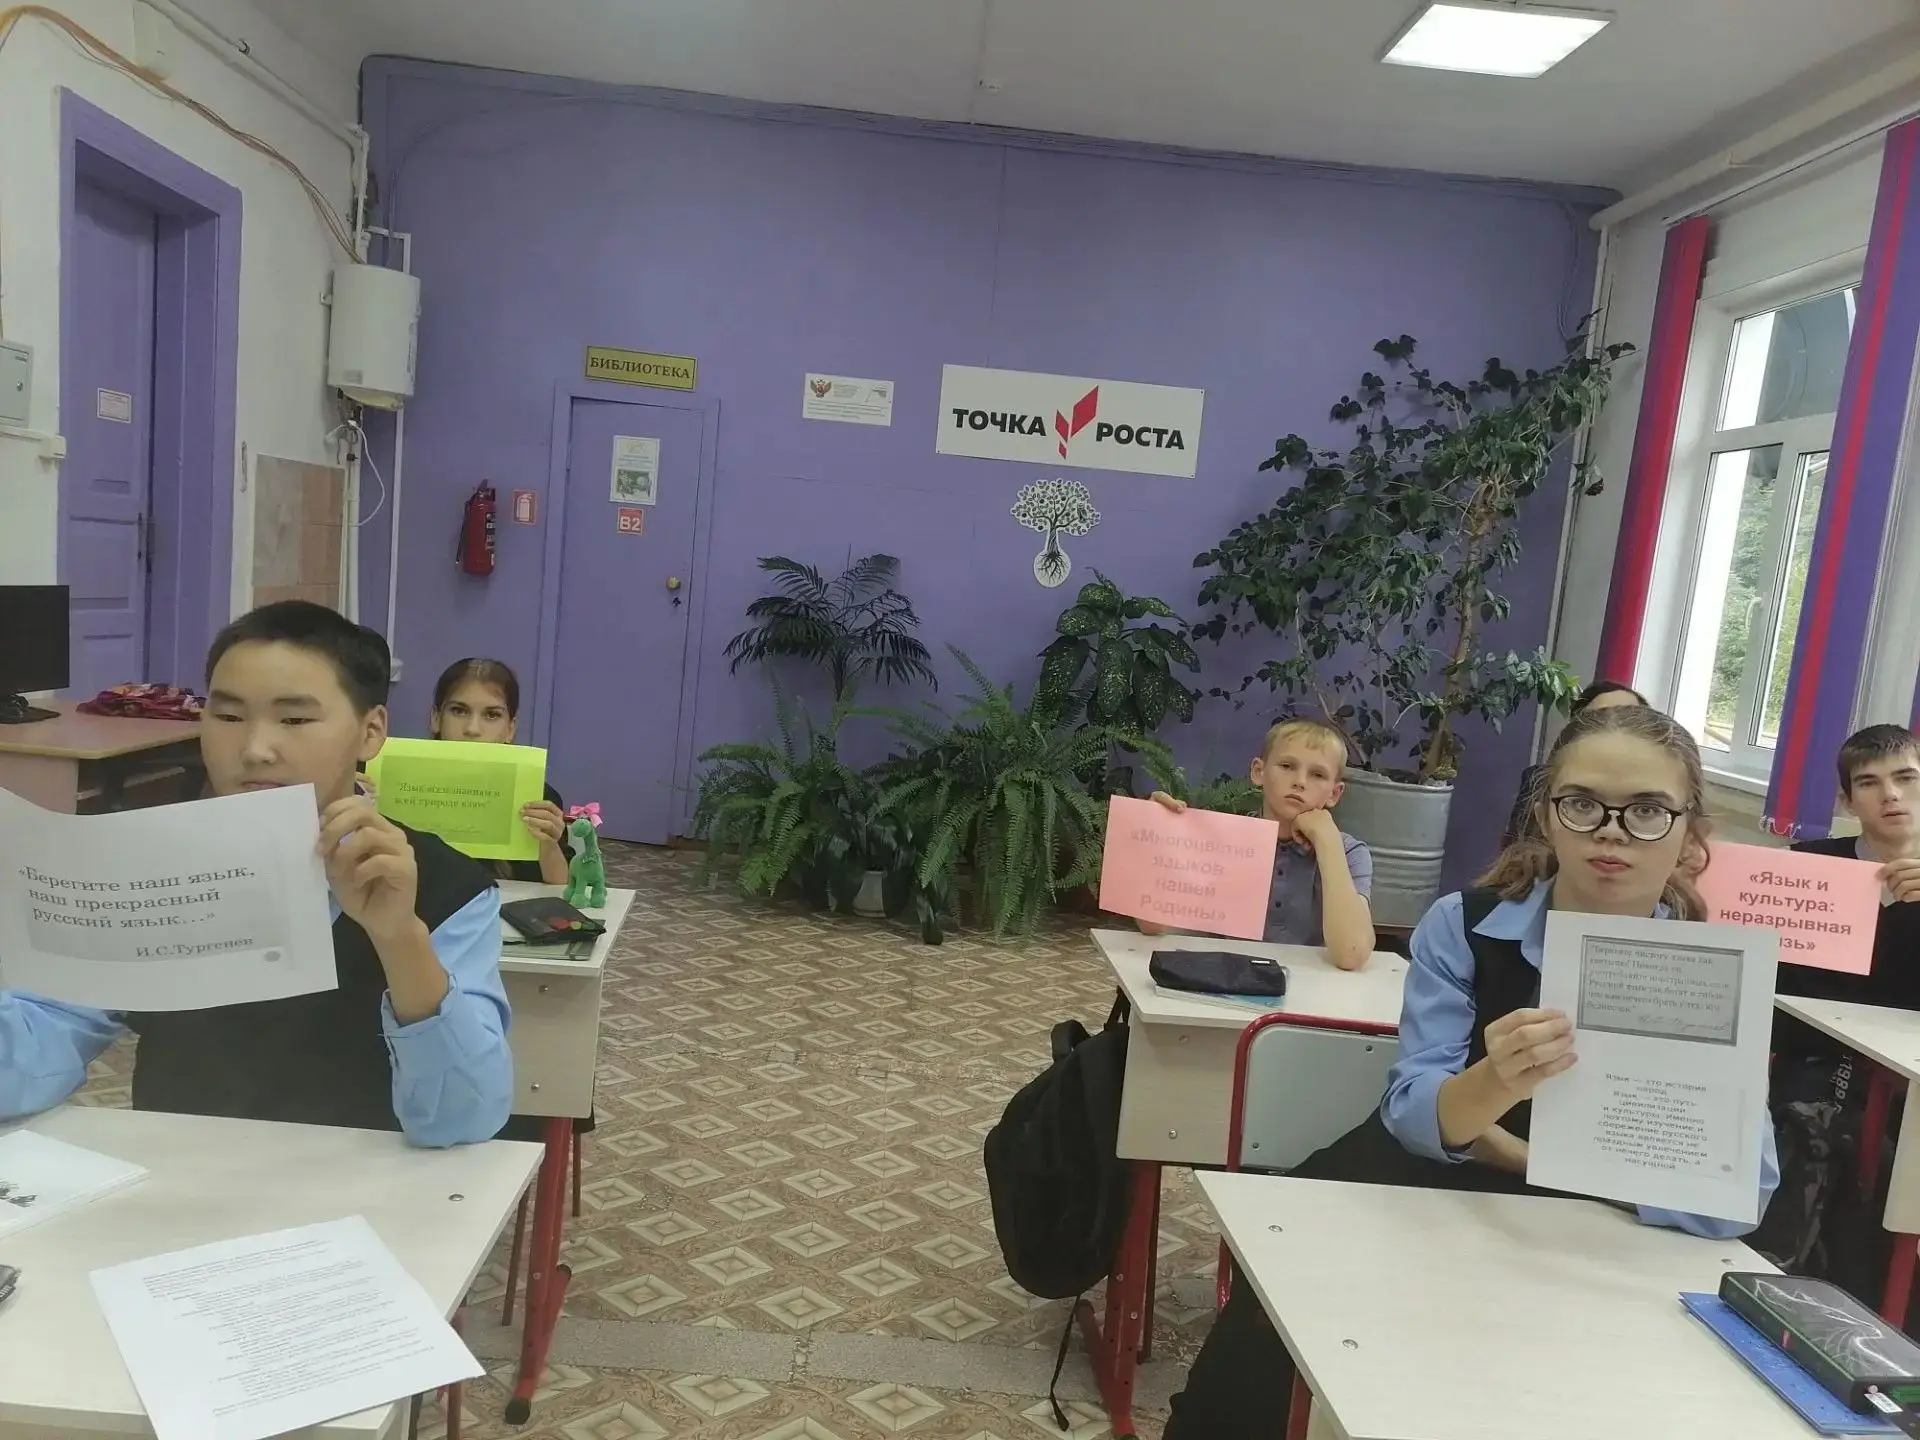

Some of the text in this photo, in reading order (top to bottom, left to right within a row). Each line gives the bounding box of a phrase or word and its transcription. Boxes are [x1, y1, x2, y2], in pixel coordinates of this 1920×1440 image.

[589, 356, 691, 379] БИБЛИОТЕКА
[952, 408, 1185, 450] ТОЧКА РОСТА
[1151, 855, 1224, 877] языков
[129, 877, 181, 891] наш
[1750, 871, 1829, 892] «Язык и
[29, 888, 220, 912] наш прекрасный
[1141, 894, 1226, 921] Родины»
[1739, 891, 1835, 913] культура:
[32, 908, 112, 929] русский
[1720, 909, 1852, 935] неразрывная
